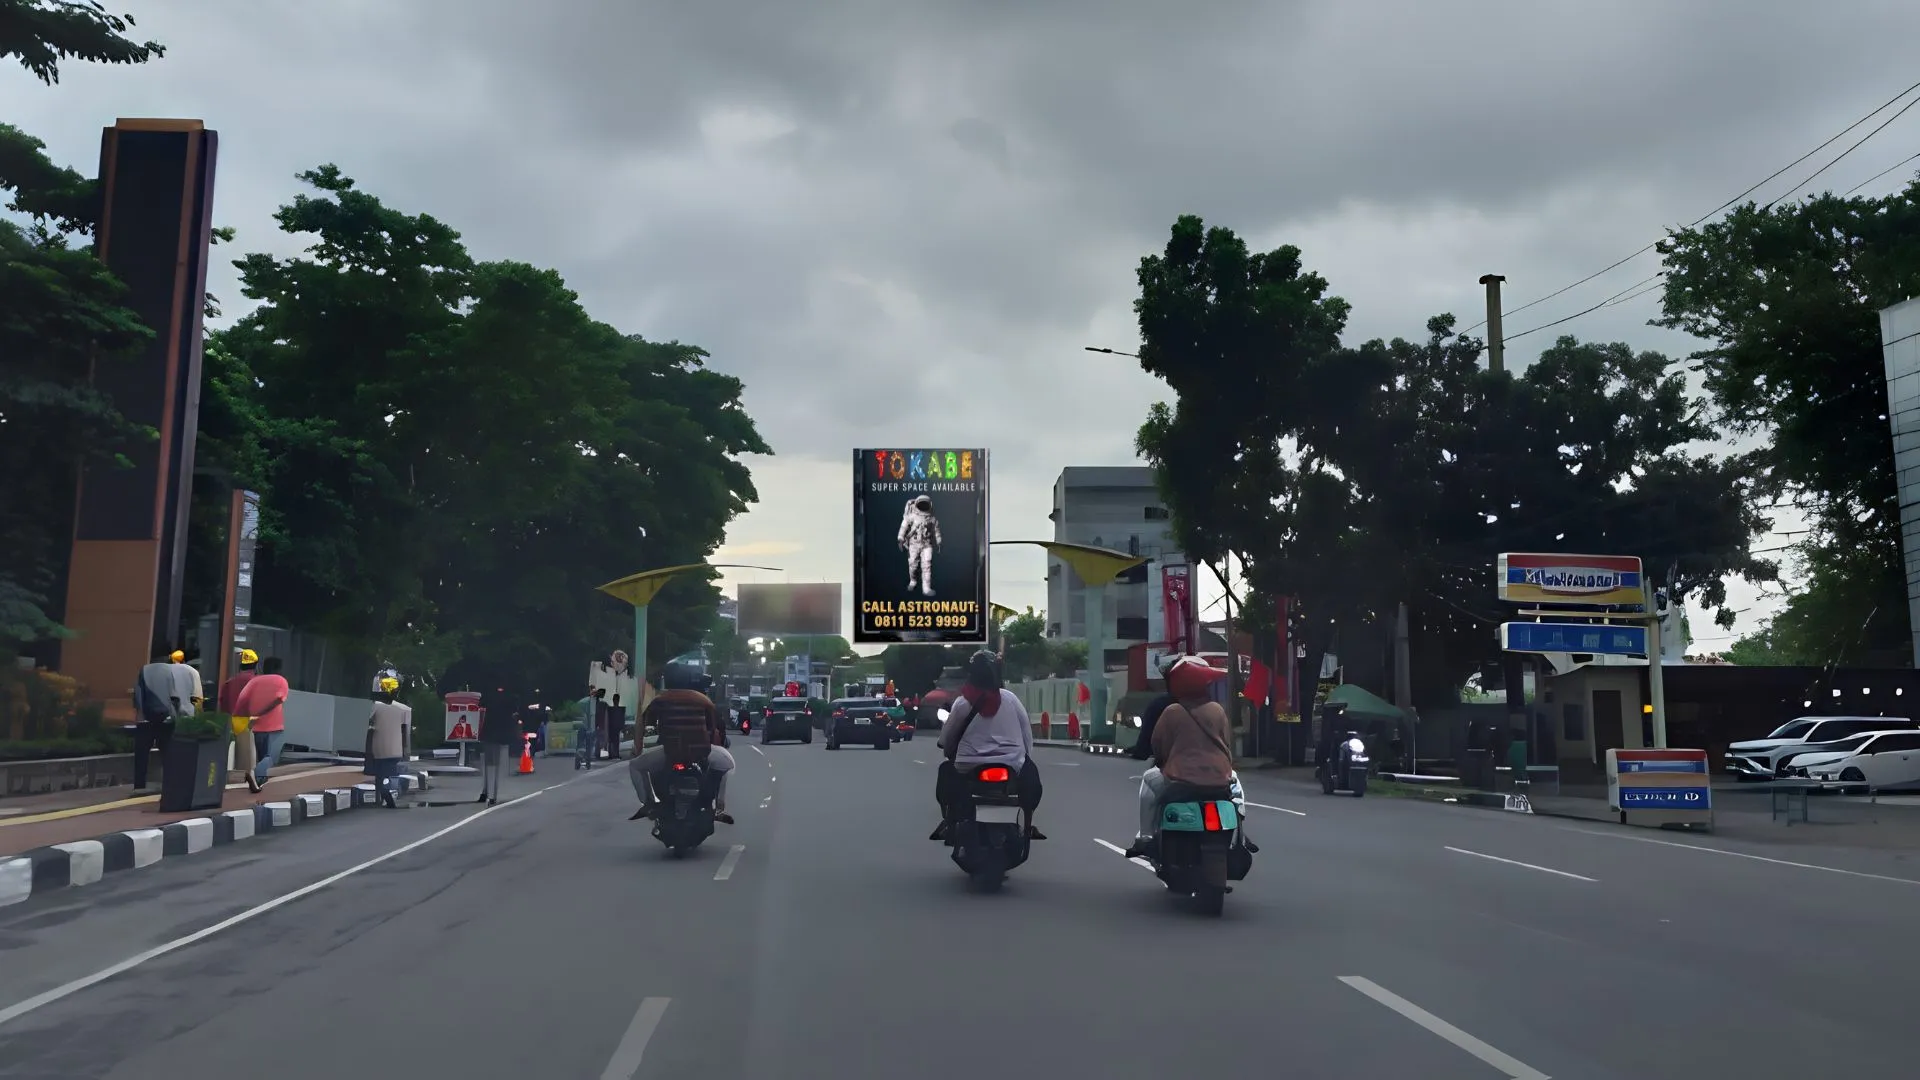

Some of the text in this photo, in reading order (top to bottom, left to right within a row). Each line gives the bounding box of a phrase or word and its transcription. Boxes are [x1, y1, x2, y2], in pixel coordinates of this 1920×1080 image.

[875, 451, 973, 480] TOKABE
[872, 483, 975, 492] SUPER SPACE AVAILABLE
[862, 601, 979, 613] CALL ASTRONAUT:
[874, 615, 968, 628] 0811 523 9999
